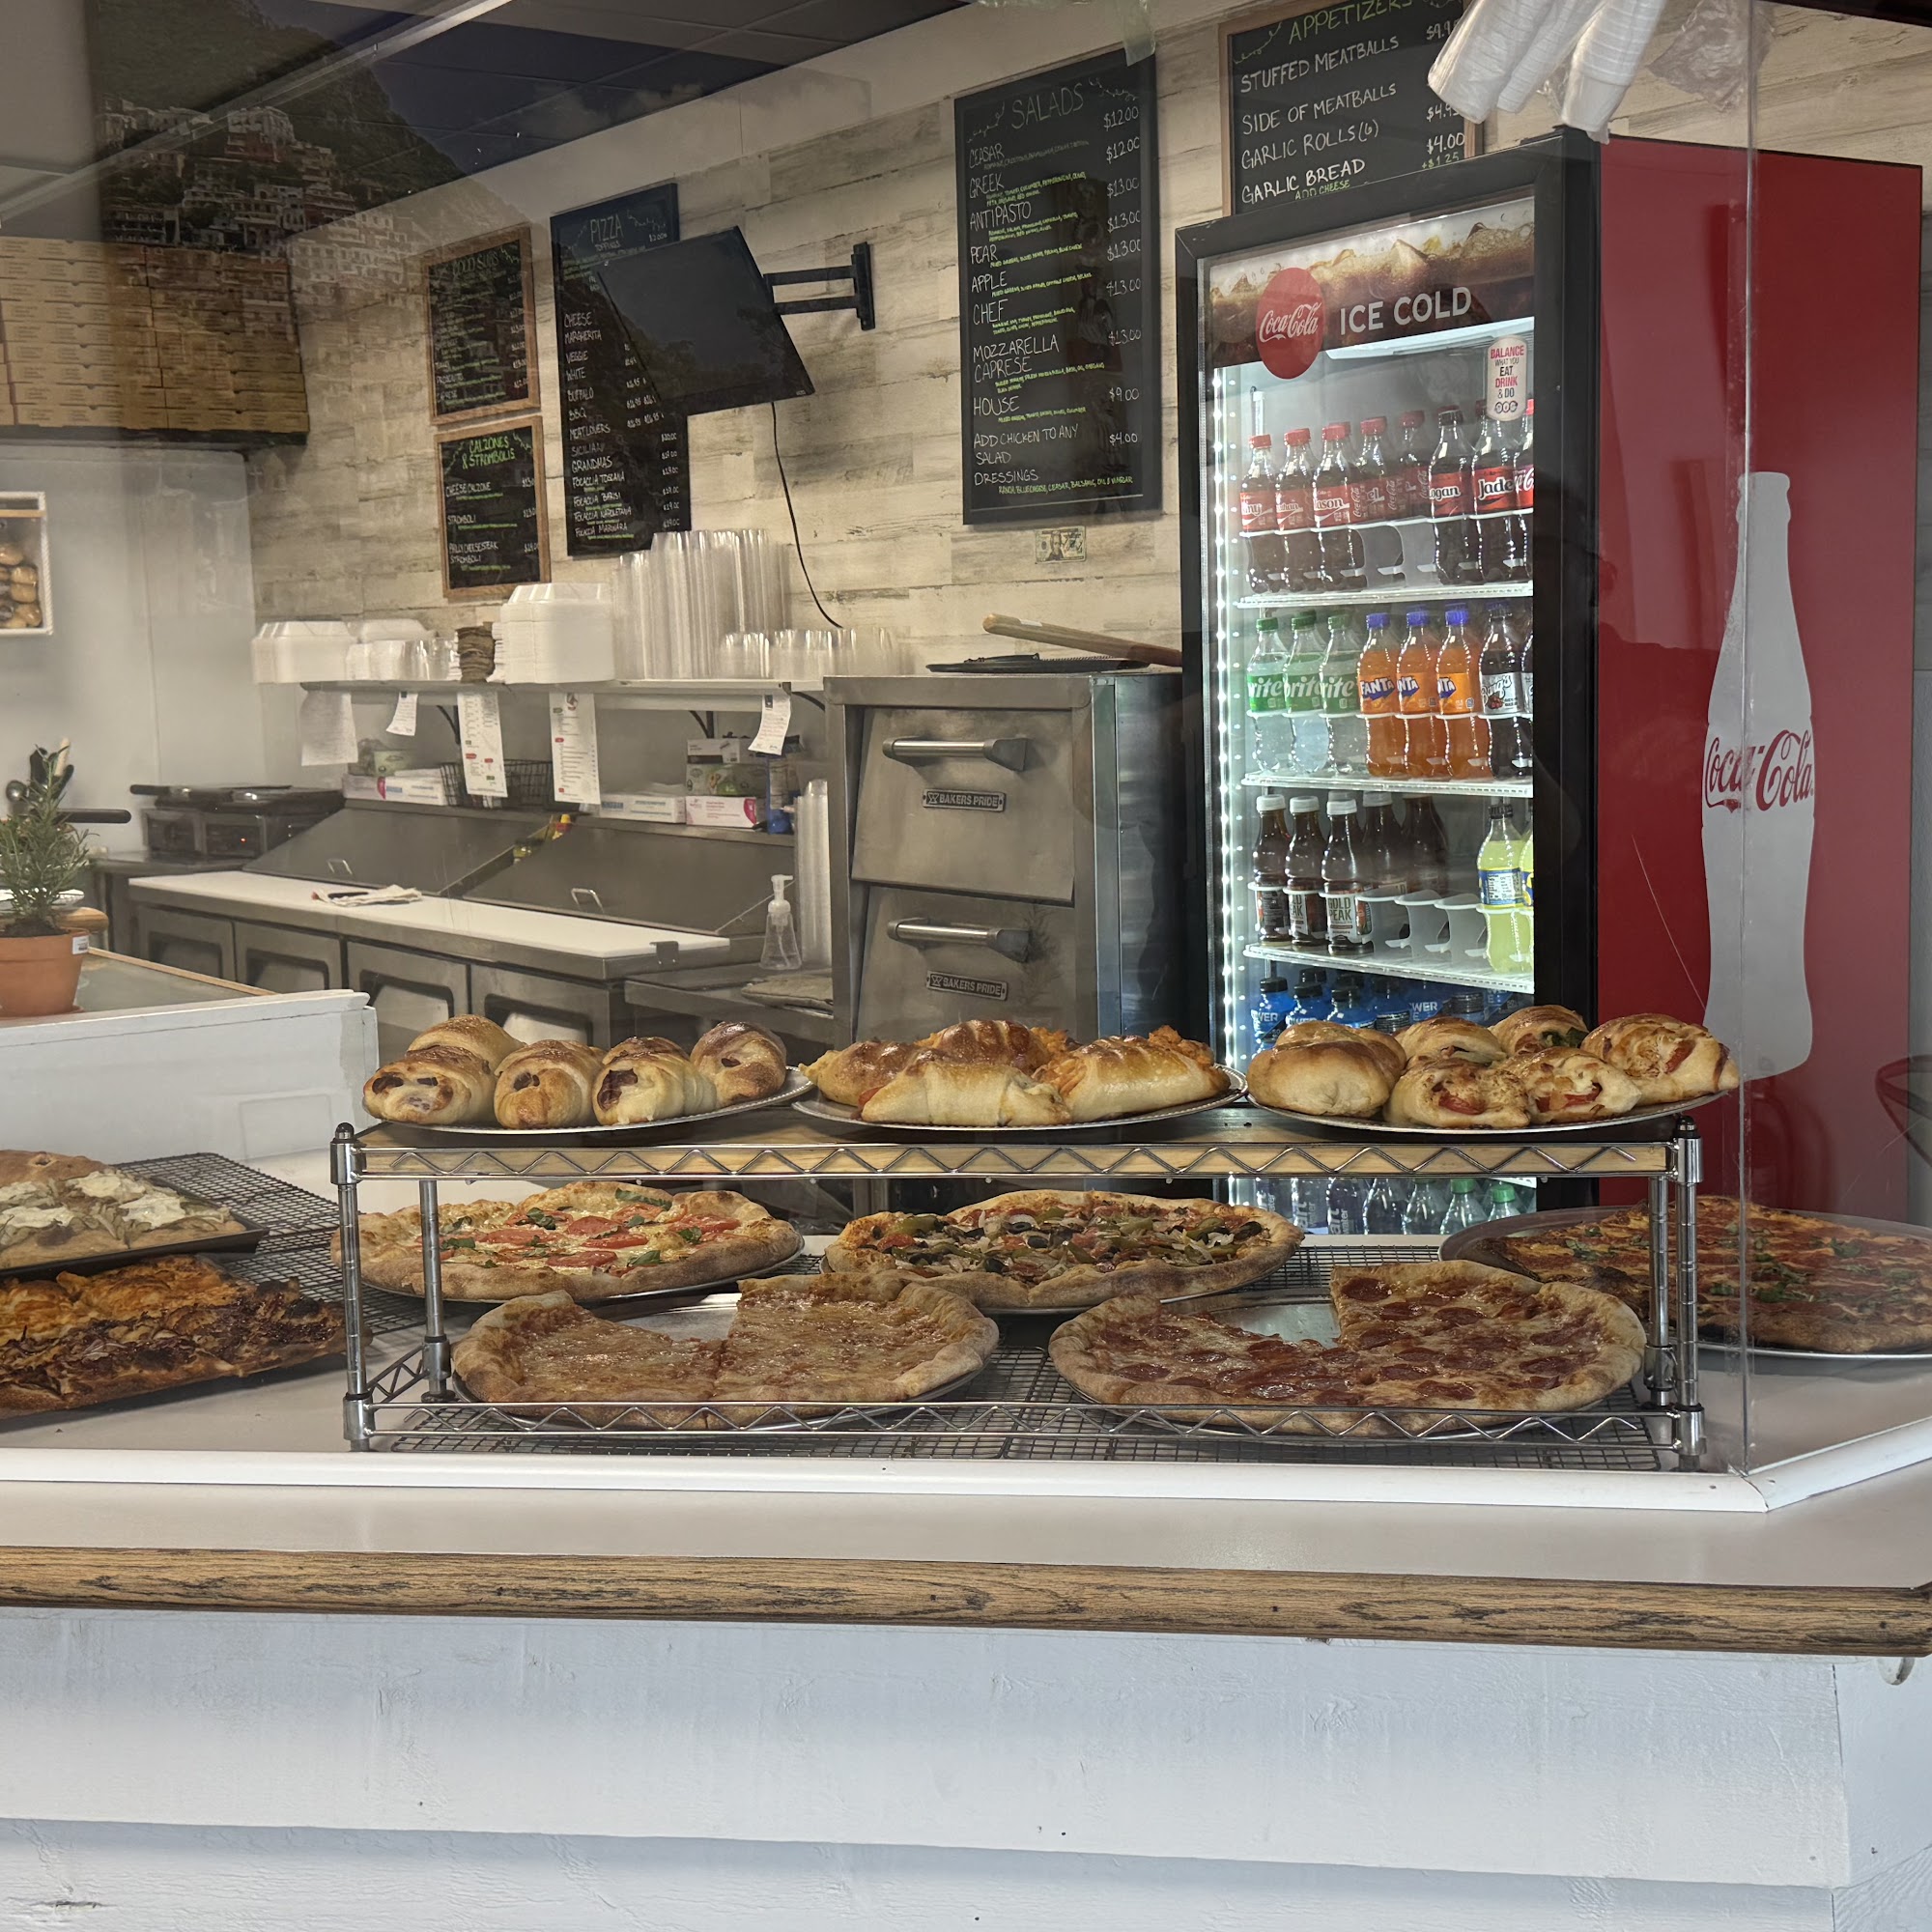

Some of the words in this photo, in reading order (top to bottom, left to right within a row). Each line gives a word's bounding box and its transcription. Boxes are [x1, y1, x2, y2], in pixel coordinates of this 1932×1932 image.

[1240, 59, 1310, 93] STUFFED
[1315, 36, 1400, 72] MEATBALLS
[1011, 83, 1084, 129] SALADS
[1242, 109, 1281, 135] SIDE
[1288, 103, 1309, 123] OF
[1314, 83, 1397, 119] MEATBALLS
[1426, 132, 1464, 155] $4.00
[969, 143, 1005, 168] CEASAR
[1241, 138, 1298, 170] GARLIC
[969, 173, 1005, 198] GREEK
[1241, 176, 1299, 205] GARLIC
[1306, 158, 1366, 186] BREAD
[1319, 179, 1350, 194] CHEESE
[970, 201, 1031, 232] ANTIPASTO
[590, 213, 624, 243] PIZZA
[970, 243, 998, 265] PEAR
[971, 270, 1008, 294] APPLE
[563, 312, 592, 328] CHEESE
[973, 298, 1009, 325] CHEF
[1340, 300, 1384, 335] ICE
[1394, 286, 1472, 326] COLD
[1260, 302, 1322, 343] Coca-Cola
[564, 329, 603, 345] MARGHERITA
[565, 350, 588, 364] VEGGIE
[973, 334, 1060, 363] MOZZARELLA
[1491, 345, 1524, 358] BALANCE
[565, 366, 586, 382] WHITE
[975, 356, 1033, 383] CAPRESE
[1499, 366, 1513, 377] EAT
[1495, 376, 1518, 388] DRINK
[567, 386, 594, 402] BUFFALO
[1497, 389, 1503, 398] &
[1504, 387, 1515, 398] DO
[568, 407, 587, 421] BBQ
[973, 395, 1020, 417] HOUSE
[469, 436, 509, 454] CALZONES
[974, 433, 998, 448] ADD
[1000, 430, 1040, 445] CHICKEN
[1041, 427, 1057, 440] TO
[1059, 423, 1078, 440] ANY
[469, 448, 516, 467] STROMBOLIS
[571, 456, 613, 473] GRANDMAS
[976, 451, 1011, 465] SALAD
[975, 469, 1039, 486] DRESSINGS
[1478, 477, 1514, 500] Jade
[1360, 677, 1394, 695] FANTA
[1705, 729, 1812, 813] Coca-Cola
[939, 794, 972, 806] BAKERS
[973, 795, 999, 807] PRIDE
[1327, 896, 1350, 910] GOLD
[1329, 909, 1352, 921] PEAK
[943, 977, 975, 991] BAKERS
[976, 982, 1002, 996] PRIDE
[1410, 1001, 1437, 1012] WER
